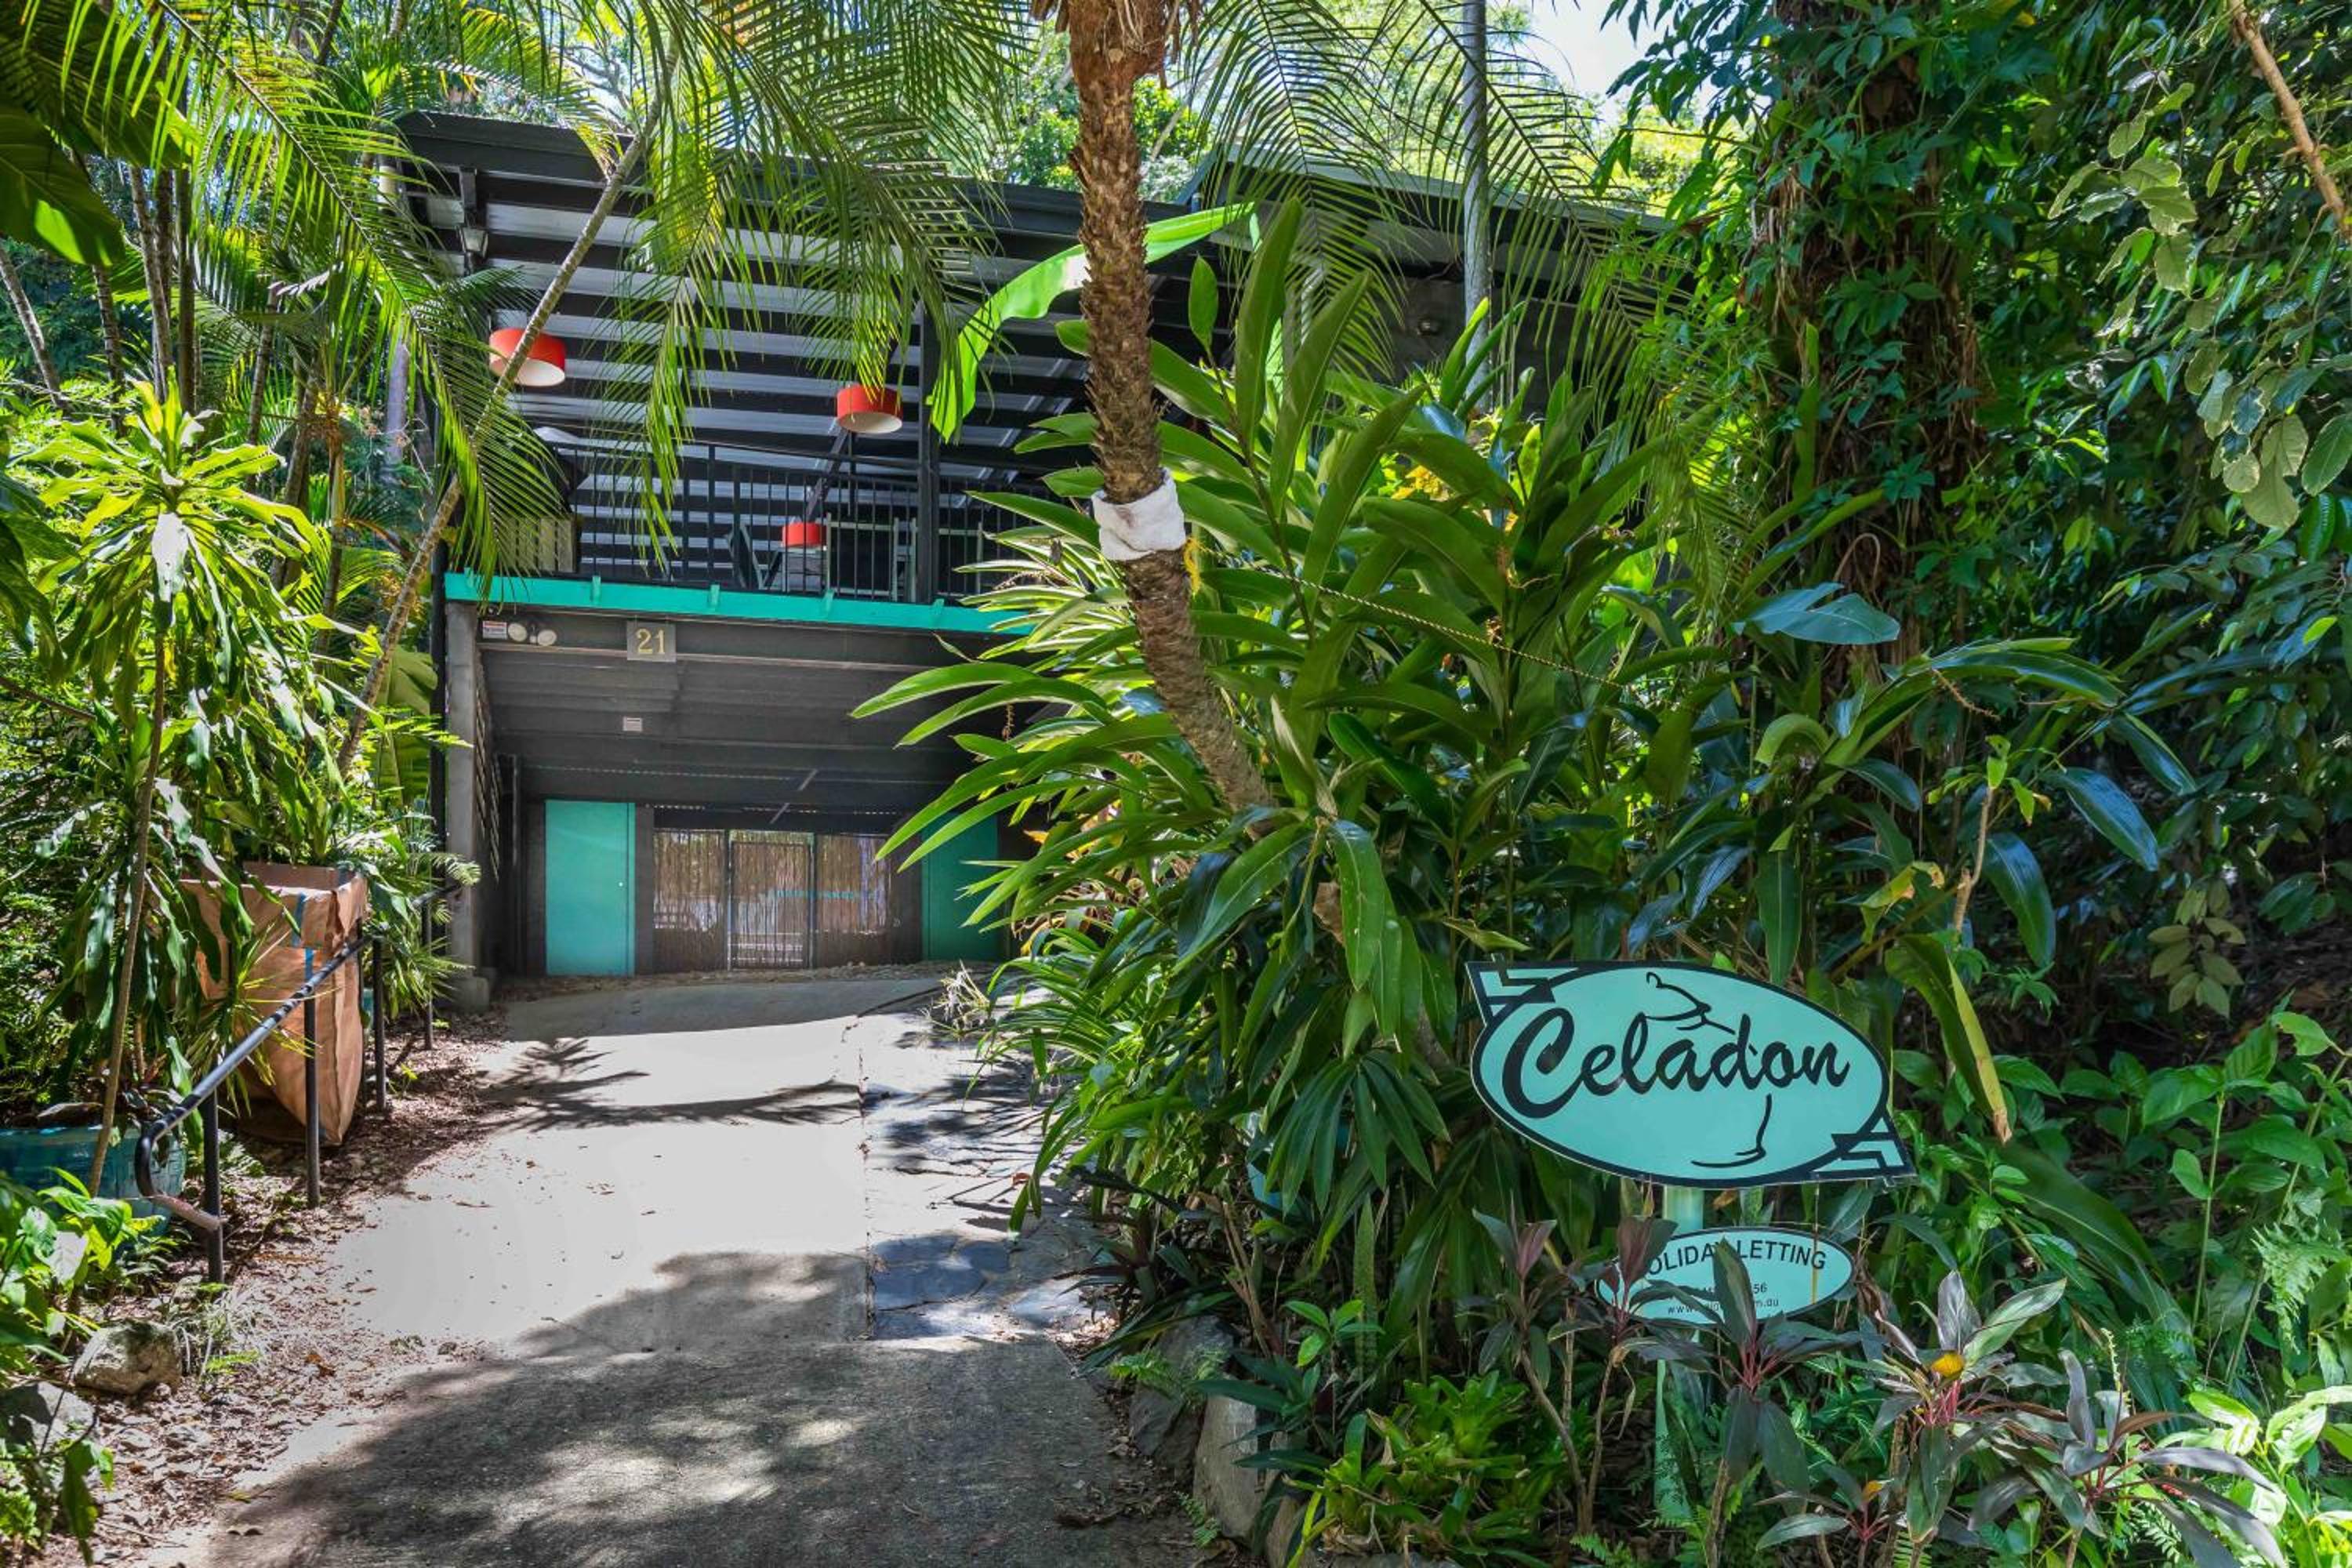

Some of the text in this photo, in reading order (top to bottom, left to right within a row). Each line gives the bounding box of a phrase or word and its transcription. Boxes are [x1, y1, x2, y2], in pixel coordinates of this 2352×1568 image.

[635, 628, 665, 654] 21
[1501, 1007, 1851, 1119] Celadon
[1647, 1240, 1827, 1275] OLIDA LETTING
